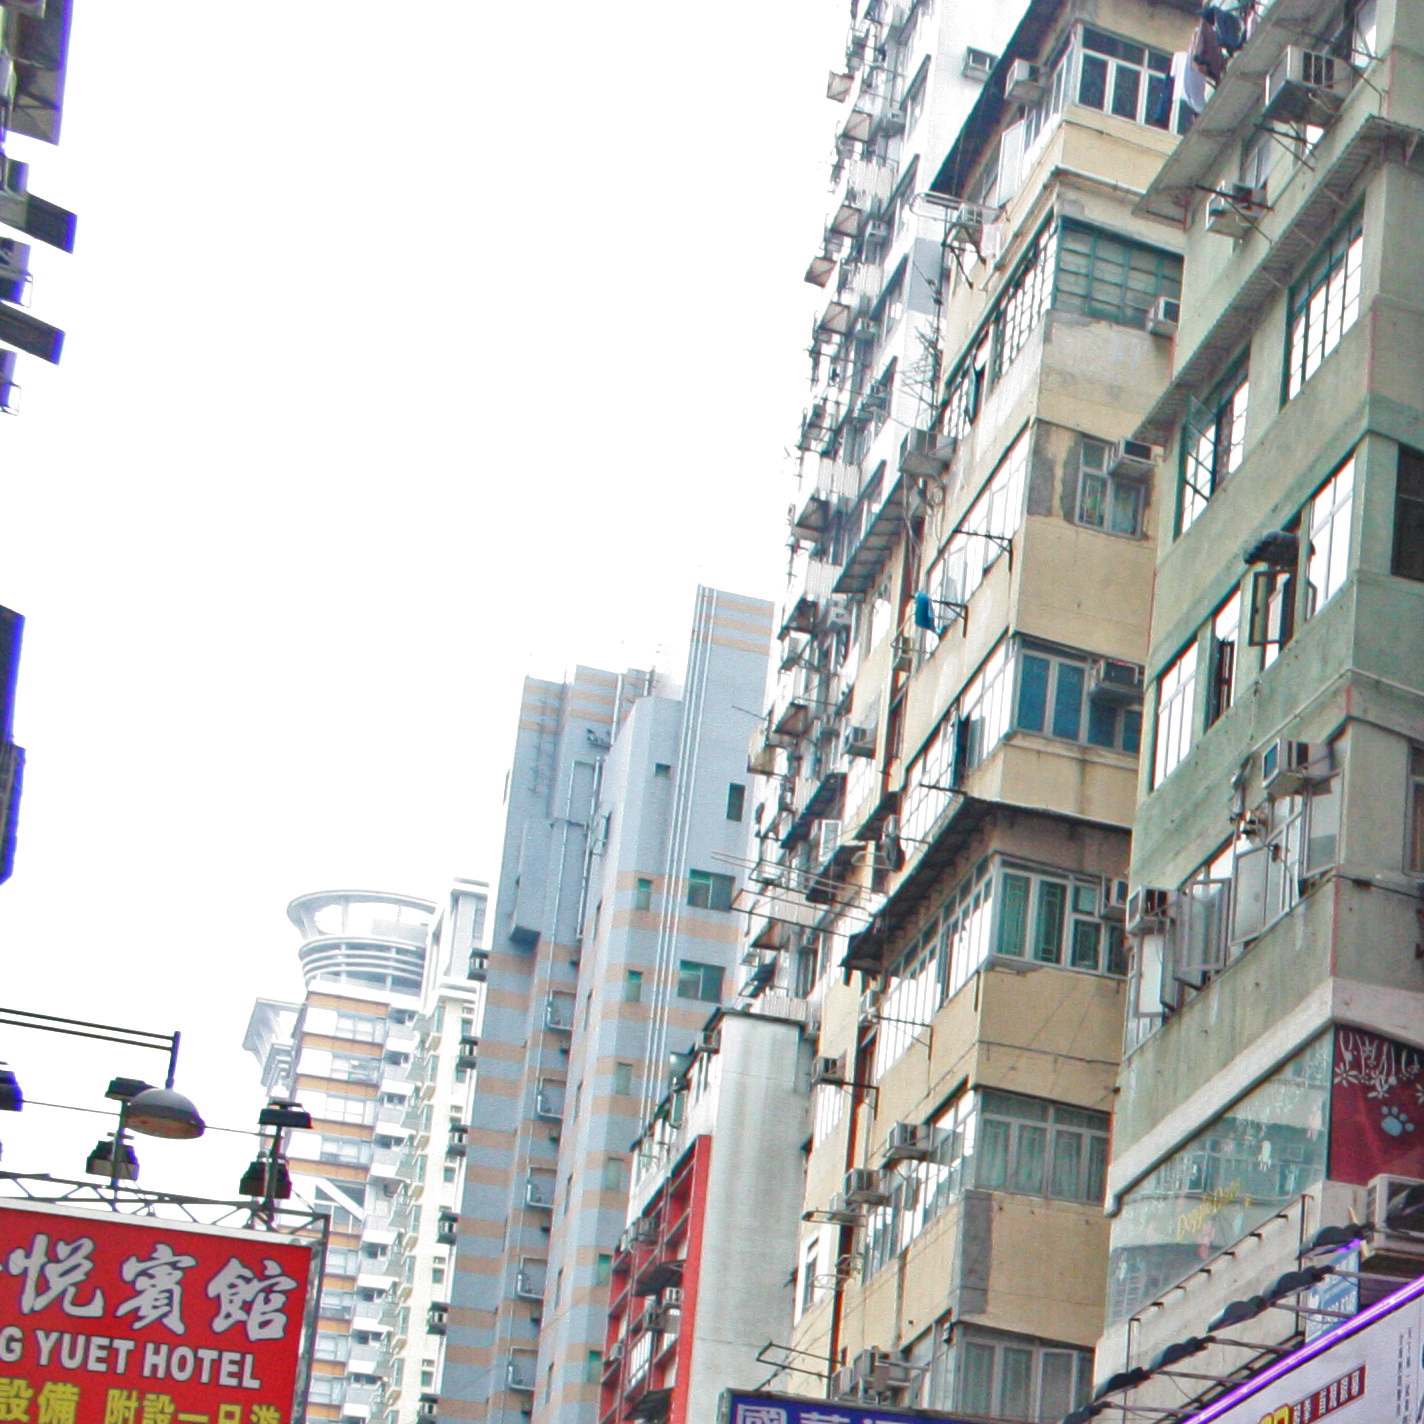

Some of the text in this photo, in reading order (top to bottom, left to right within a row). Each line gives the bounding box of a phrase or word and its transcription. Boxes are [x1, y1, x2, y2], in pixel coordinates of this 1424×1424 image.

[0, 1233, 298, 1342] 悅賓館
[35, 1329, 262, 1390] YUET HOTEL
